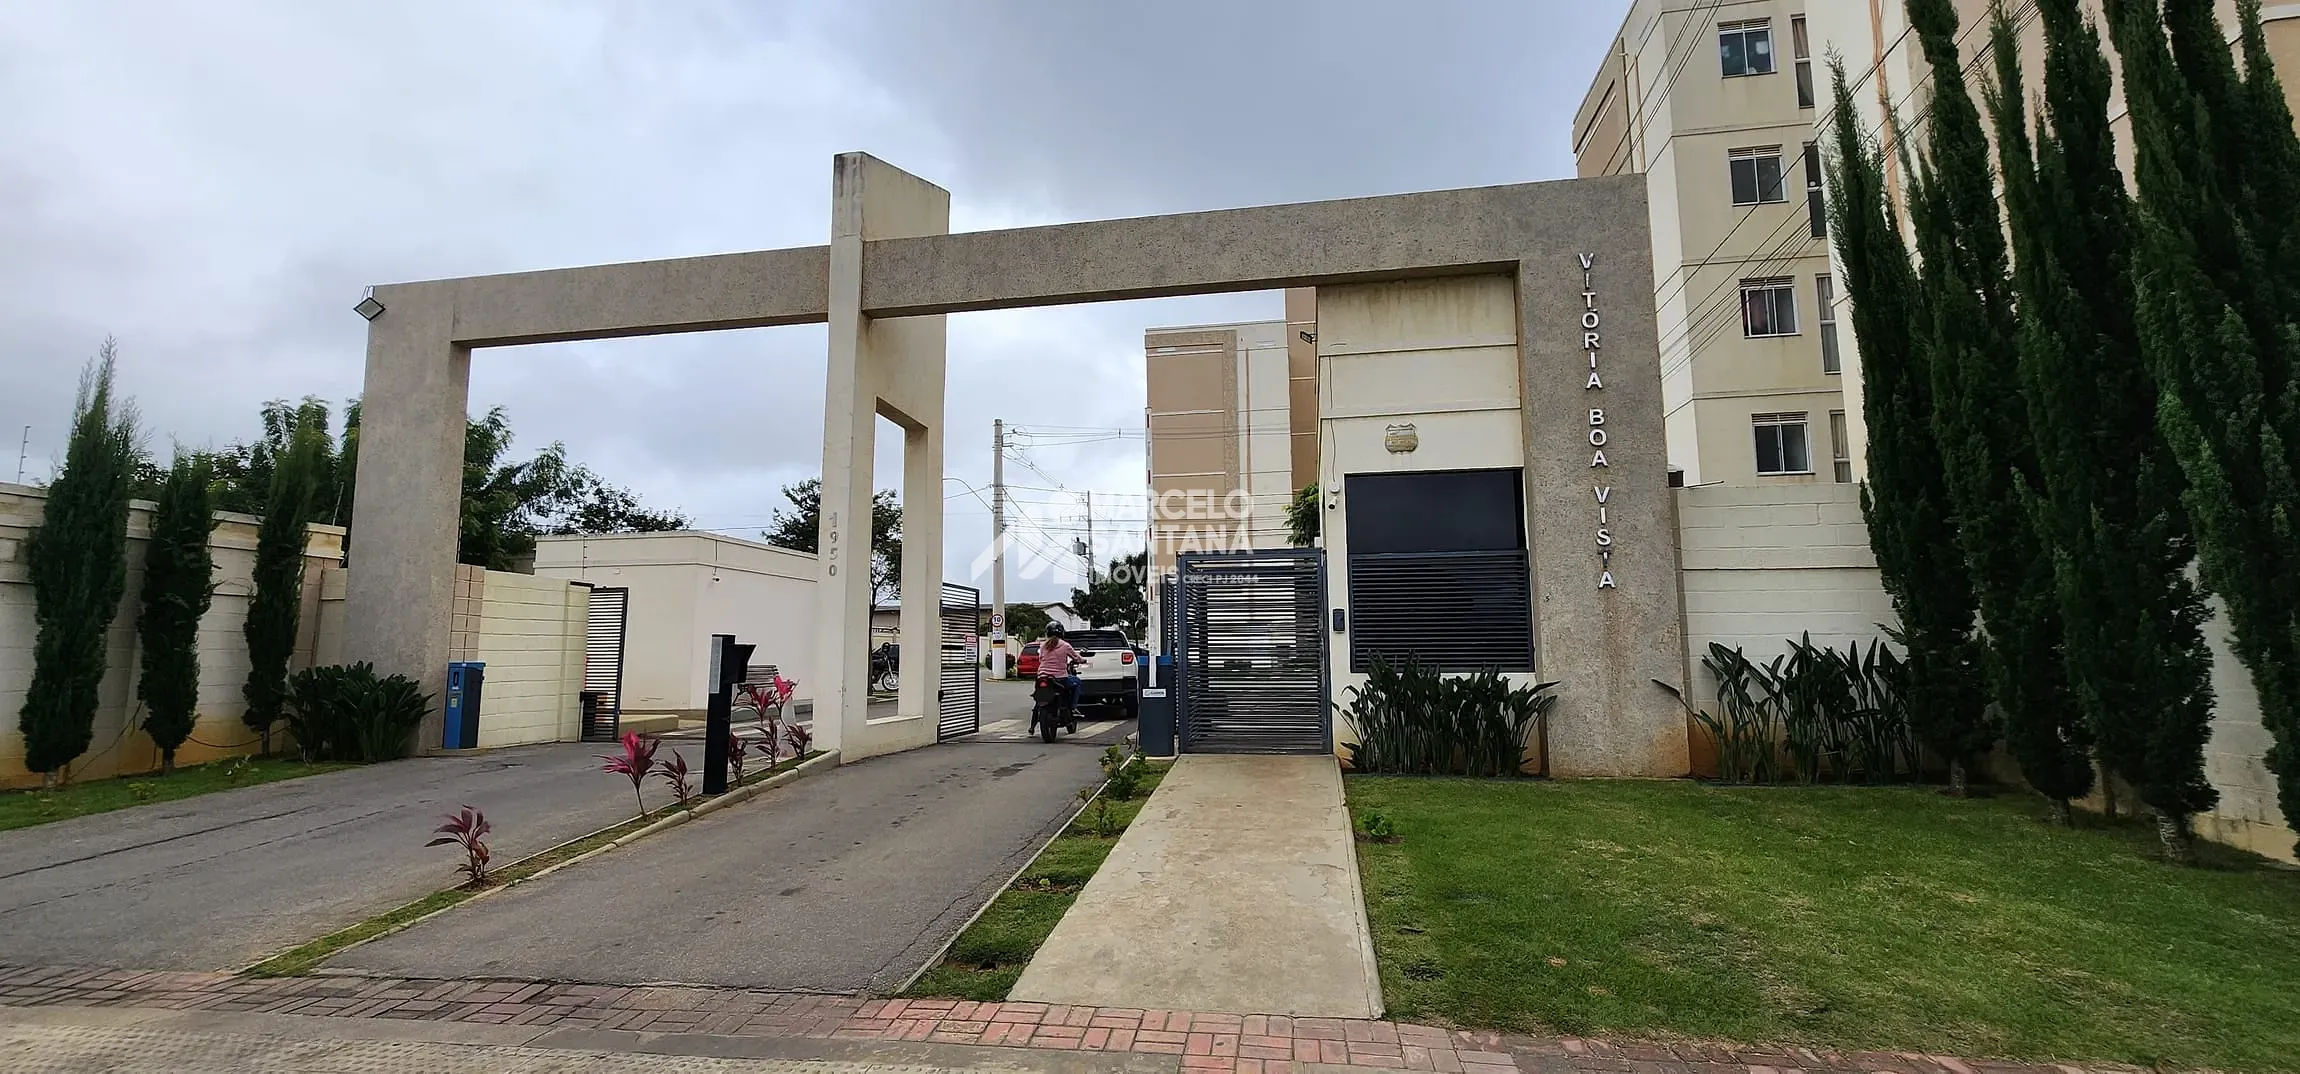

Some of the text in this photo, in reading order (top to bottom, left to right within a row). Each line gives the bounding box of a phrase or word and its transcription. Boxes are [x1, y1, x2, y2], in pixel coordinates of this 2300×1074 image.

[1578, 252, 1616, 589] VITÓRIA BOA VISTA
[828, 511, 839, 577] 1950
